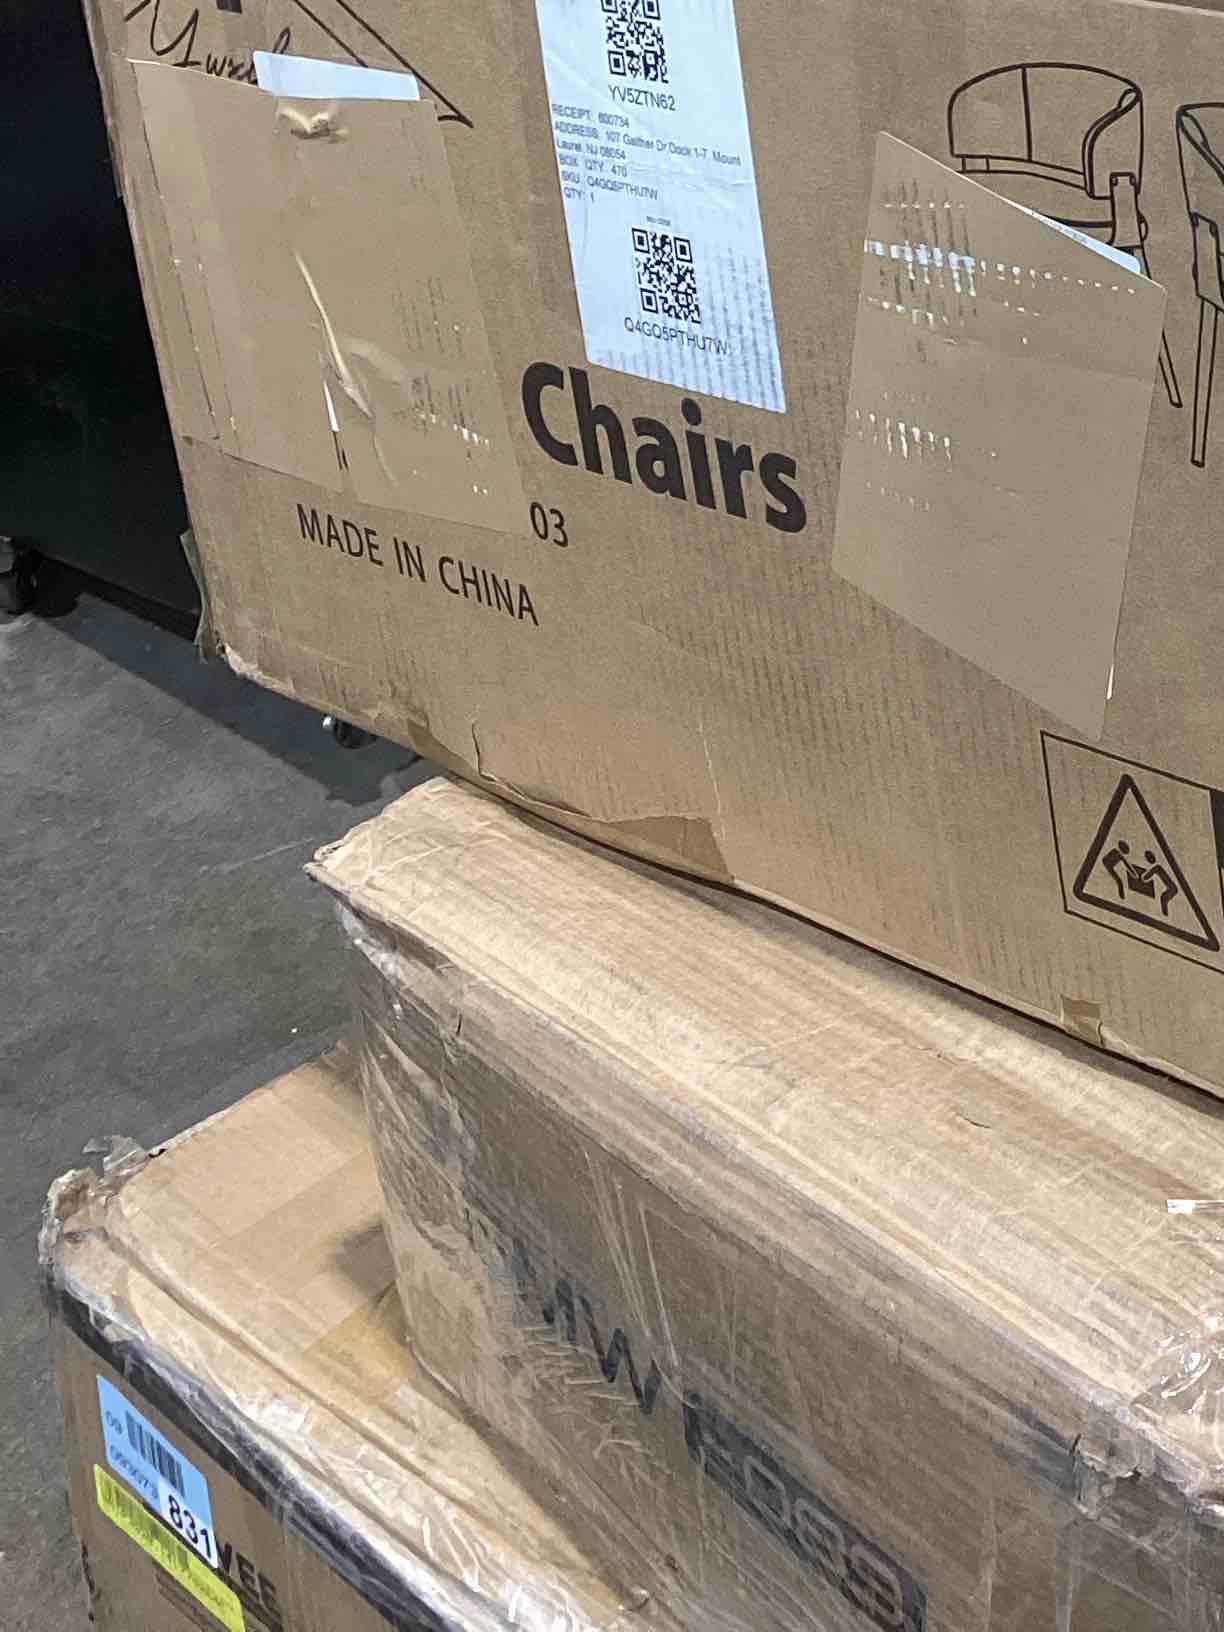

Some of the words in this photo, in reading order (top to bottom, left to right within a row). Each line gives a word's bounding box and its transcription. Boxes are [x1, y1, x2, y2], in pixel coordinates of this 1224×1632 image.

[608, 85, 677, 111] YV5ZTN62
[521, 361, 808, 535] Chairs
[529, 501, 569, 549] 03
[296, 503, 384, 567] MADE
[393, 537, 428, 583] IN
[437, 554, 540, 627] CHINA
[167, 1494, 213, 1560] 831
